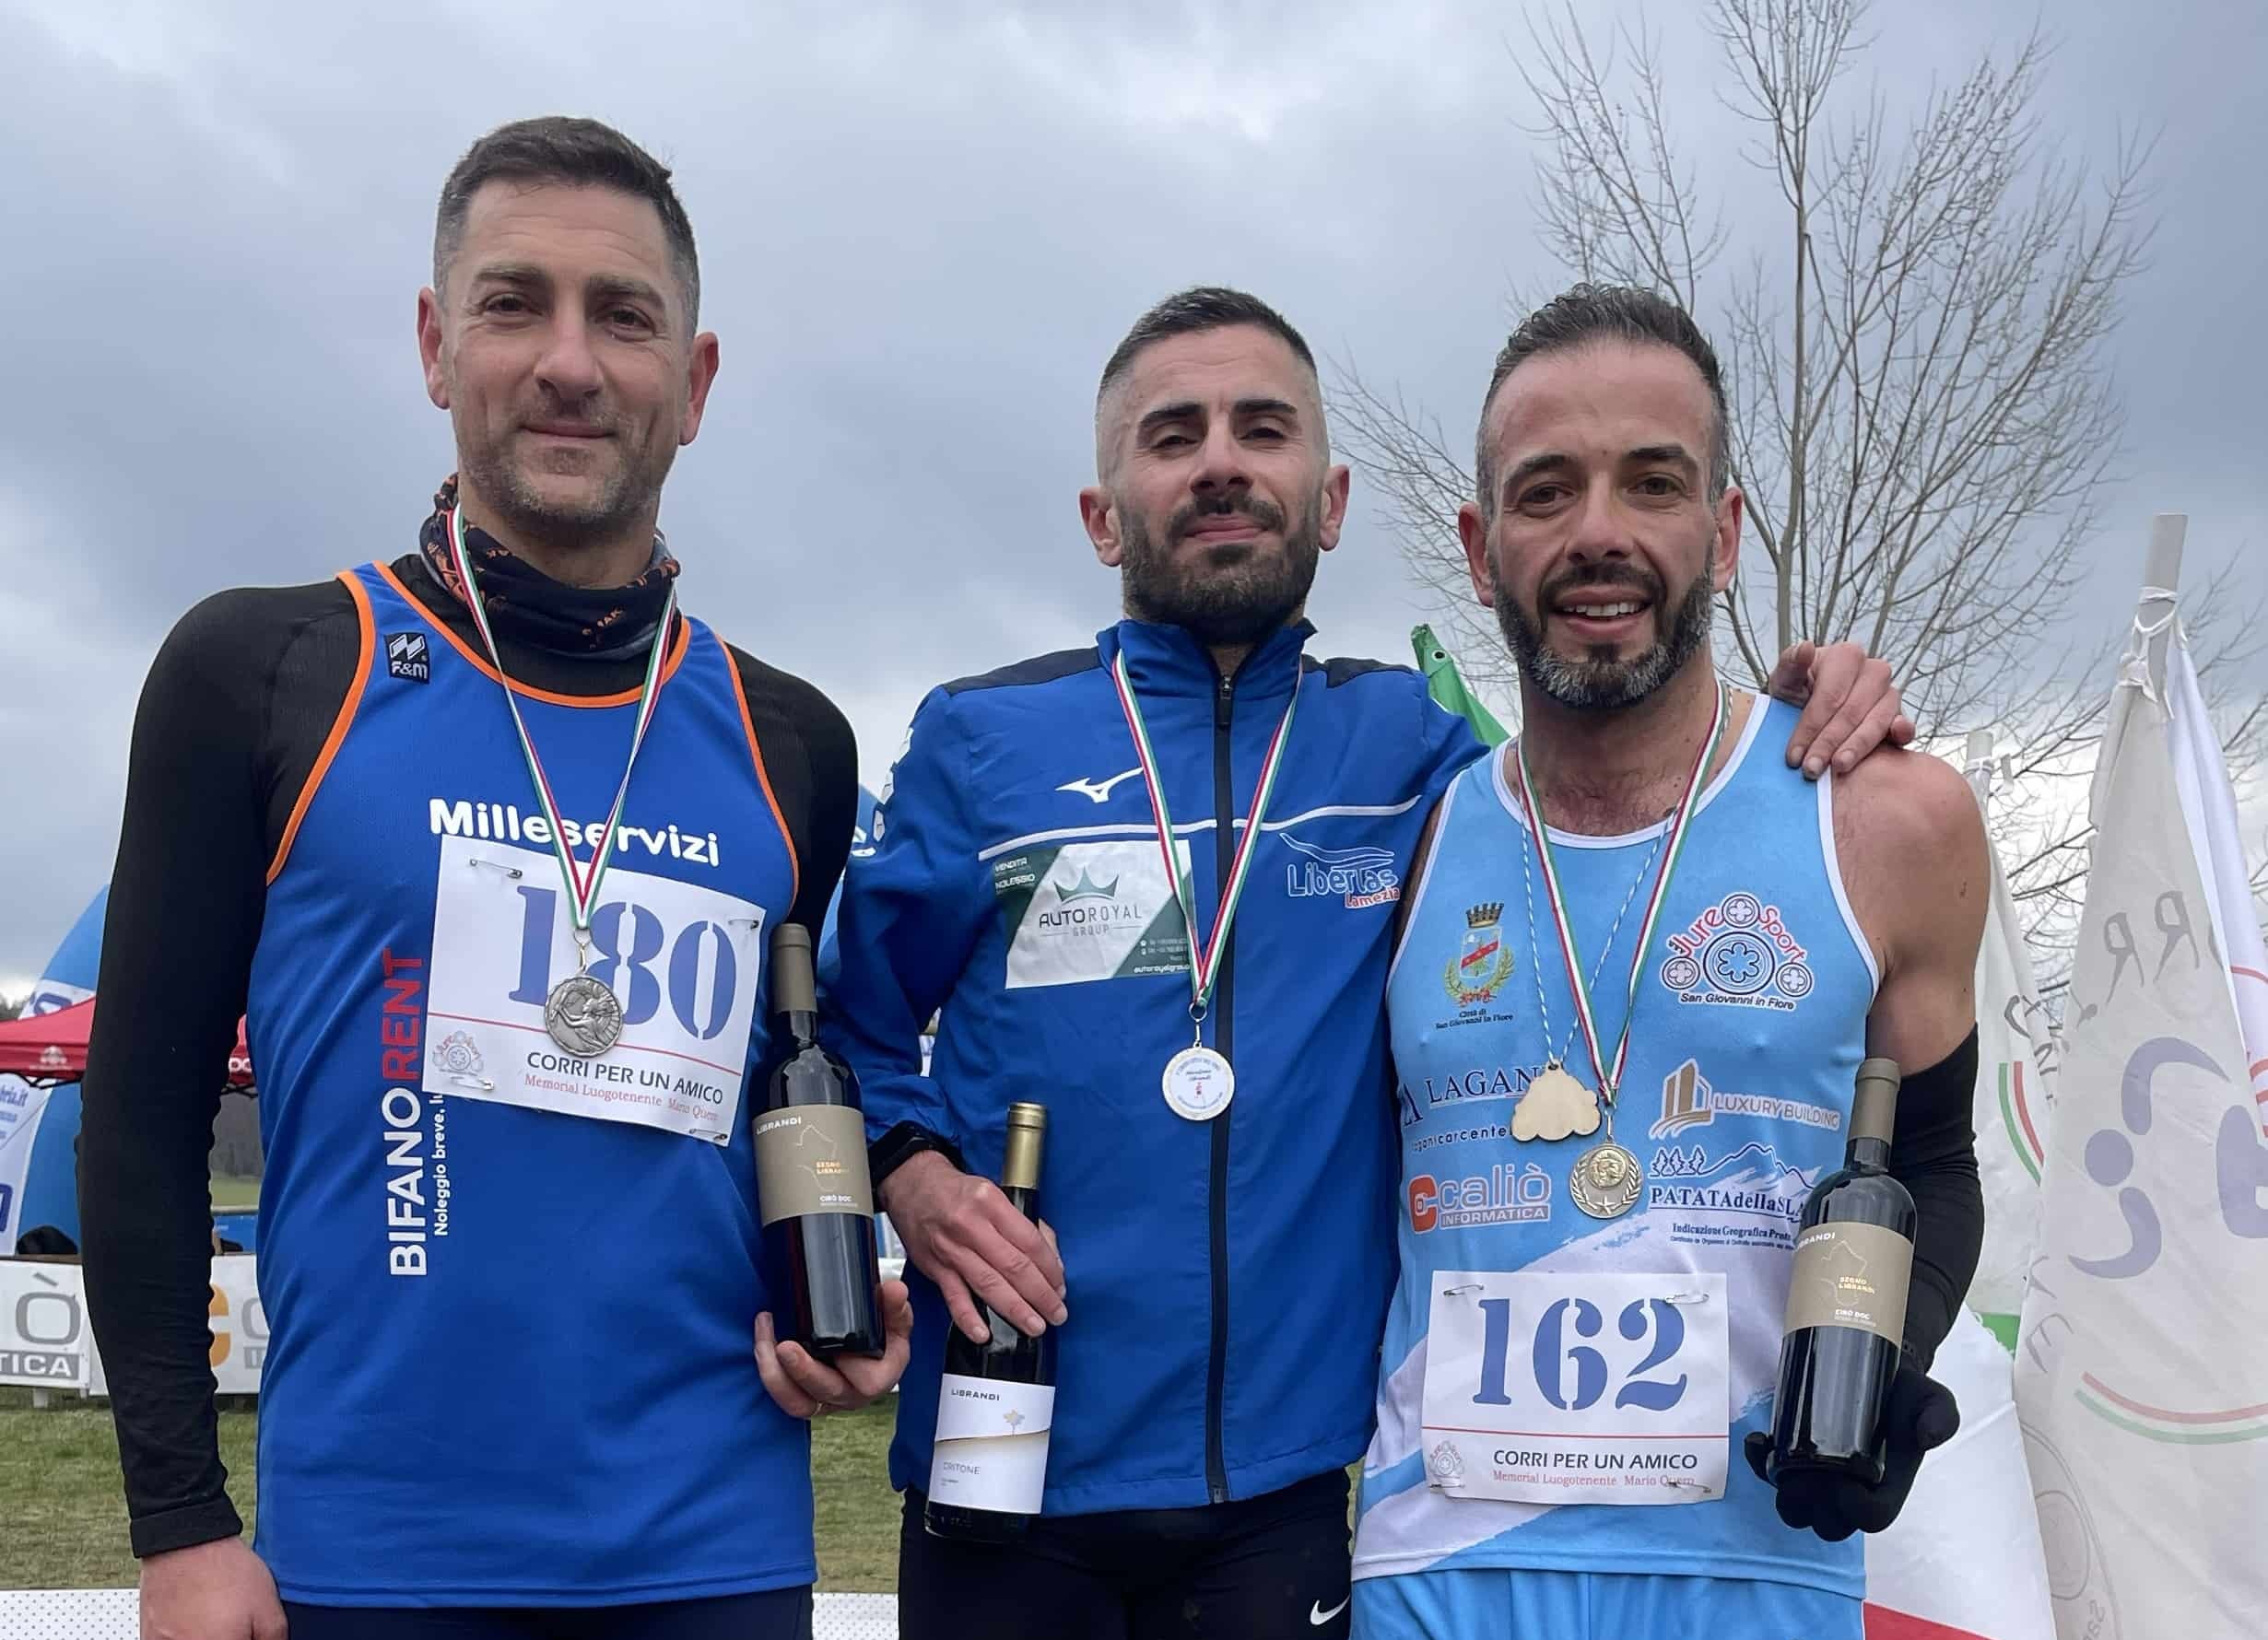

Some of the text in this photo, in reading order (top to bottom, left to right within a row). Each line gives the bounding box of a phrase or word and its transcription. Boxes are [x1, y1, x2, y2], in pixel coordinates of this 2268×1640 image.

[429, 798, 721, 868] Milleservizi
[1287, 861, 1399, 897] Libertas
[1039, 903, 1144, 930] AUTOROYAL
[1073, 924, 1110, 938] GROUP
[509, 885, 736, 1040] 180
[382, 947, 423, 1080] RENT
[1681, 992, 1795, 1010] San Giovanni in Fiore
[523, 1073, 579, 1095] Memorial
[582, 1084, 663, 1107] Luogotenente
[526, 1051, 723, 1105] CORRI PER UN AMICO
[756, 1117, 802, 1135] LIBRANDI
[1714, 1095, 1840, 1130] LUXURY BUILDING
[382, 1087, 428, 1276] BIFANO
[432, 1162, 451, 1236] Noleggio
[1442, 1208, 1546, 1226] INFORMATICA
[1672, 1223, 1721, 1236] Indicazione
[1722, 1225, 1768, 1239] Geografica
[1473, 1297, 1688, 1412] 162
[951, 1388, 1001, 1401] LIBRANDI
[1493, 1449, 1698, 1470] CORRI PER UN AMICO
[1492, 1470, 1539, 1484] Memorial
[1543, 1472, 1617, 1488] Luogotenente
[1624, 1474, 1657, 1487] Mario
